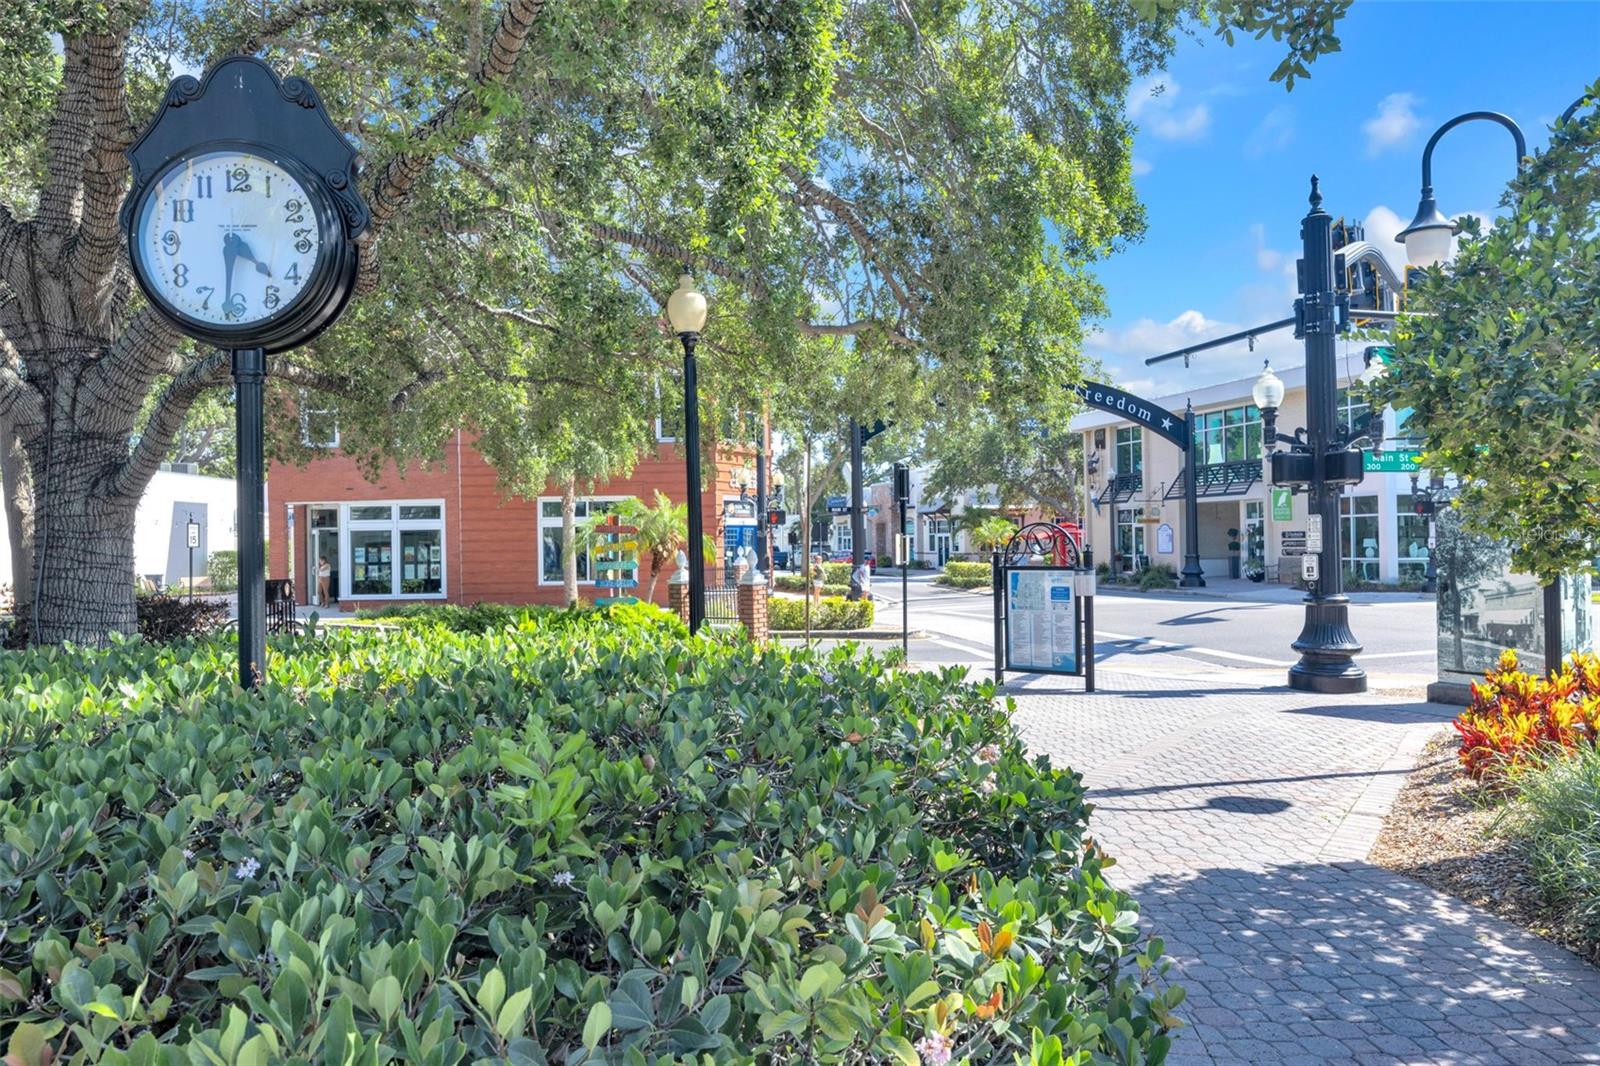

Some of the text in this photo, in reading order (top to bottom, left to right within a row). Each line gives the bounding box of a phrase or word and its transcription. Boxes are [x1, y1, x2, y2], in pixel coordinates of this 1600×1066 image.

[197, 175, 212, 199] 11
[226, 168, 252, 192] 12
[265, 175, 271, 199] 1
[172, 199, 194, 223] 10
[284, 199, 304, 223] 2
[162, 230, 181, 256] 9
[293, 228, 313, 254] 3
[172, 263, 189, 288] 8
[284, 262, 302, 286] 4
[196, 286, 215, 310] 7
[230, 293, 247, 317] 6
[263, 285, 280, 309] 5
[1399, 453, 1409, 462] St
